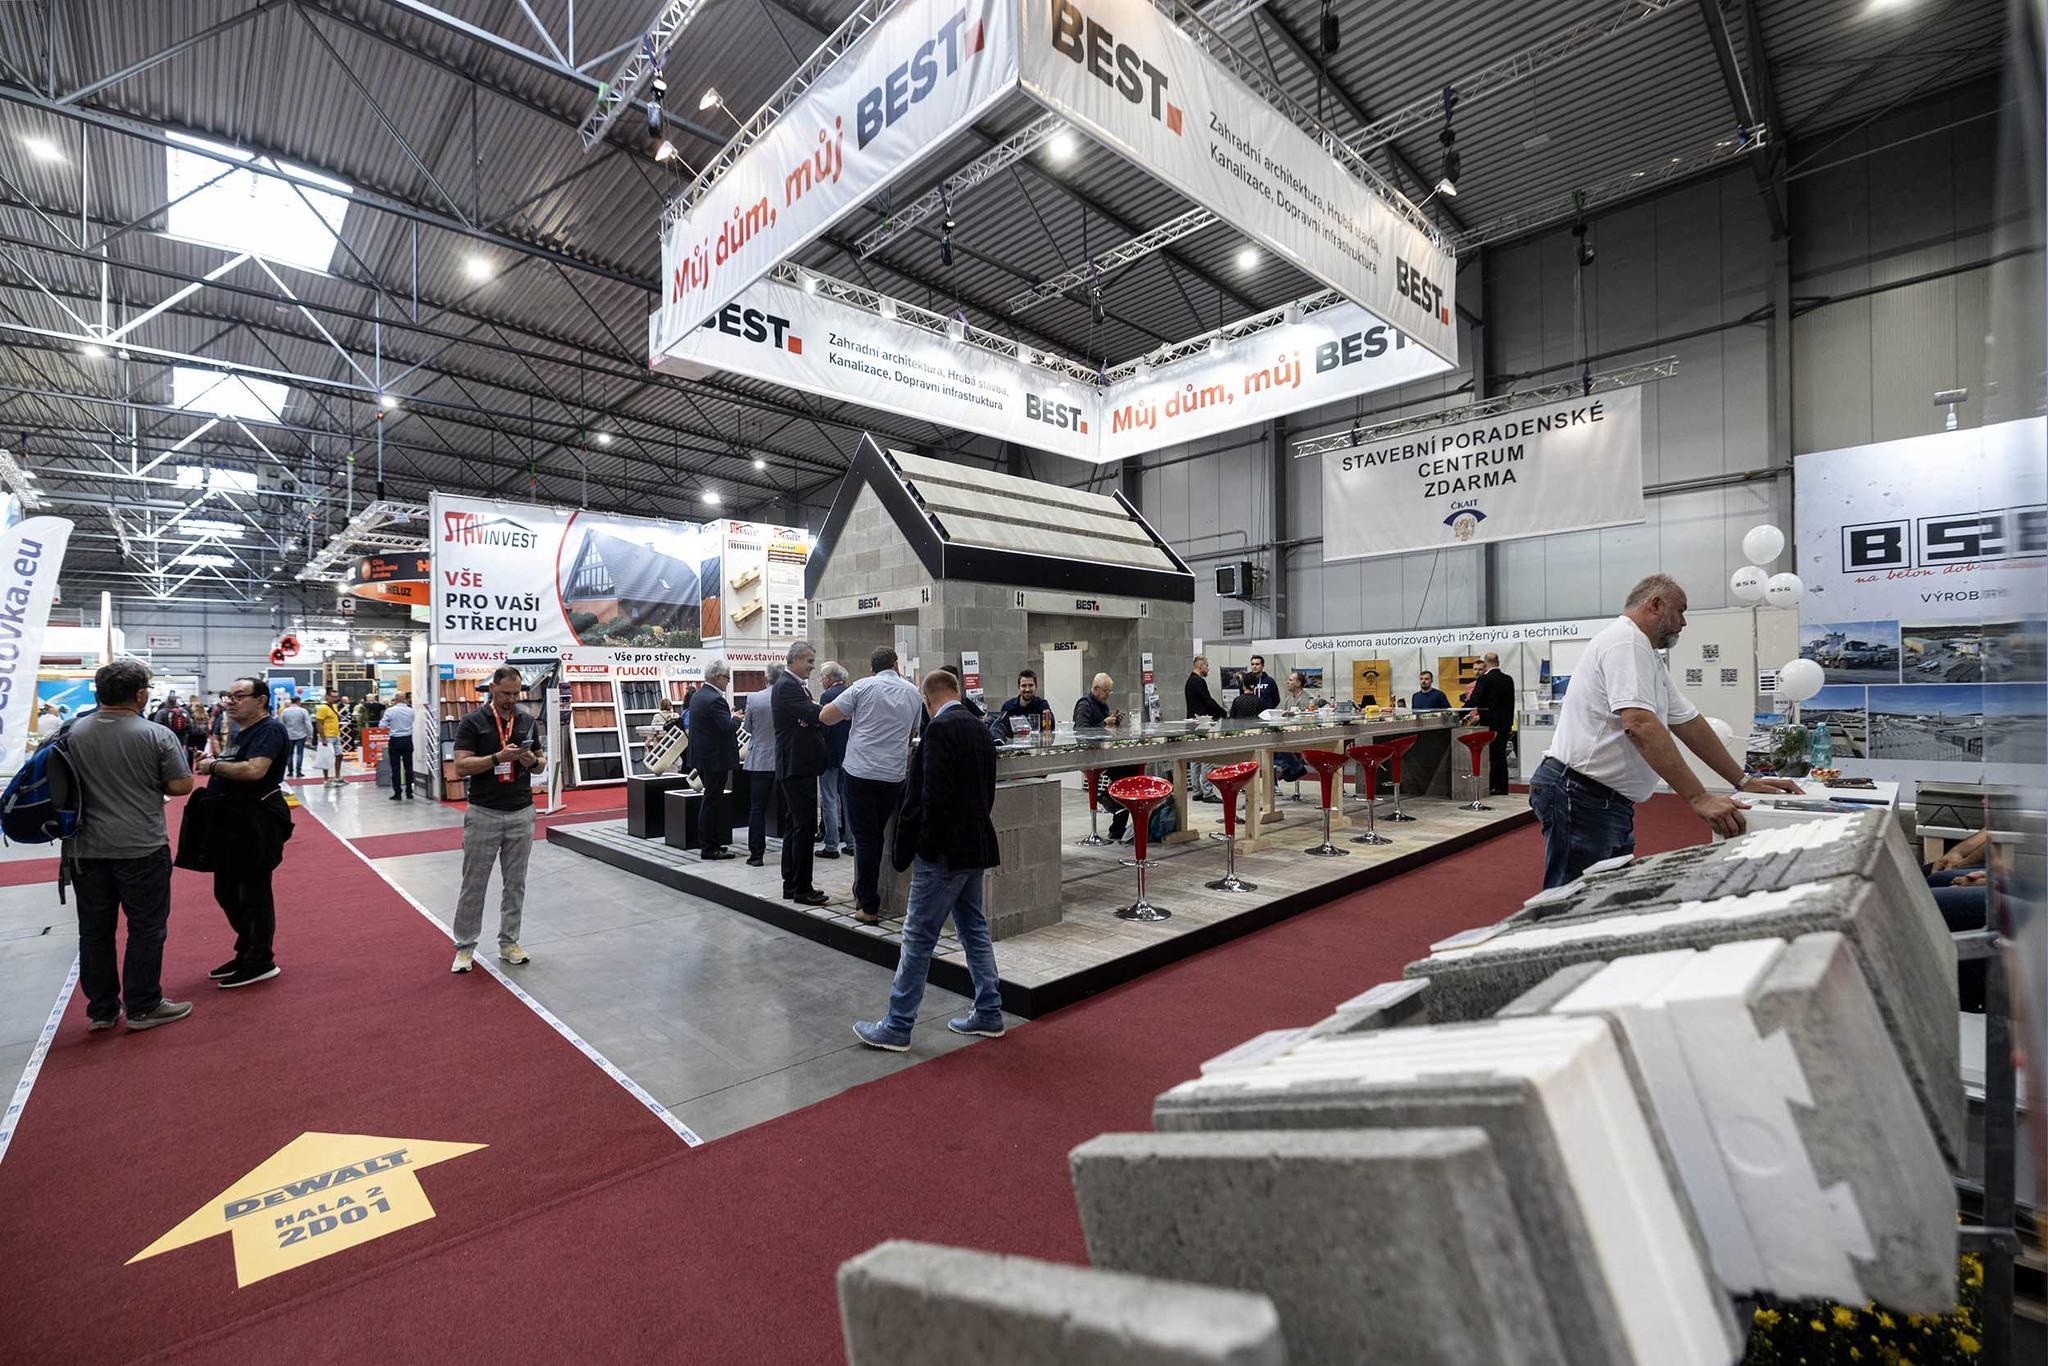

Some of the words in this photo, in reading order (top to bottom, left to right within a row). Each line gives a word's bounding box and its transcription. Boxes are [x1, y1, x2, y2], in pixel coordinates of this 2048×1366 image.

[1209, 111, 1262, 164] Zahradní
[1264, 156, 1325, 215] architektura,
[1327, 200, 1353, 234] Hrubá
[672, 239, 711, 304] Můj
[714, 197, 776, 267] dům,
[785, 115, 844, 208] můj
[1210, 141, 1274, 204] Kanalizace,
[1276, 190, 1321, 233] Dopravní
[1322, 222, 1377, 275] infrastruktura
[828, 332, 880, 358] Zahradní
[882, 350, 946, 379] architektura,
[947, 369, 976, 388] Hrubá
[978, 377, 1009, 398] stavba,
[829, 351, 892, 381] Kanalizace,
[894, 370, 940, 394] Dopravní
[942, 383, 1003, 411] infrastruktura
[1112, 400, 1157, 434] Můj
[1164, 383, 1233, 420] dům,
[1243, 351, 1302, 396] můj
[1341, 435, 1439, 472] STAVEBNÍ
[1441, 400, 1606, 453] PORADENSKÉ
[1418, 444, 1525, 478] CENTRUM
[1424, 470, 1516, 499] ZDARMA
[444, 568, 482, 588] VŠE
[1855, 574, 1879, 584] na
[1887, 568, 1935, 581] beton
[445, 593, 488, 610] PRO
[494, 593, 540, 611] VAŠI
[445, 611, 538, 632] STŘECHU
[1304, 639, 1334, 651] Česká
[1336, 638, 1372, 648] komora
[1375, 632, 1456, 647] autorizovaných
[1458, 628, 1509, 643] inženýrů
[1512, 630, 1520, 639] a
[1523, 624, 1579, 637] techniků
[522, 645, 558, 654] FAKRO
[614, 652, 633, 662] Vše
[634, 653, 652, 664] pro
[654, 652, 691, 665] střechy
[726, 652, 788, 663] www.stavinv
[676, 667, 702, 675] Lindab
[224, 1149, 413, 1221] DEWALT
[275, 1195, 356, 1229] HALA
[366, 1186, 384, 1198] 2
[277, 1196, 392, 1249] 2D01
